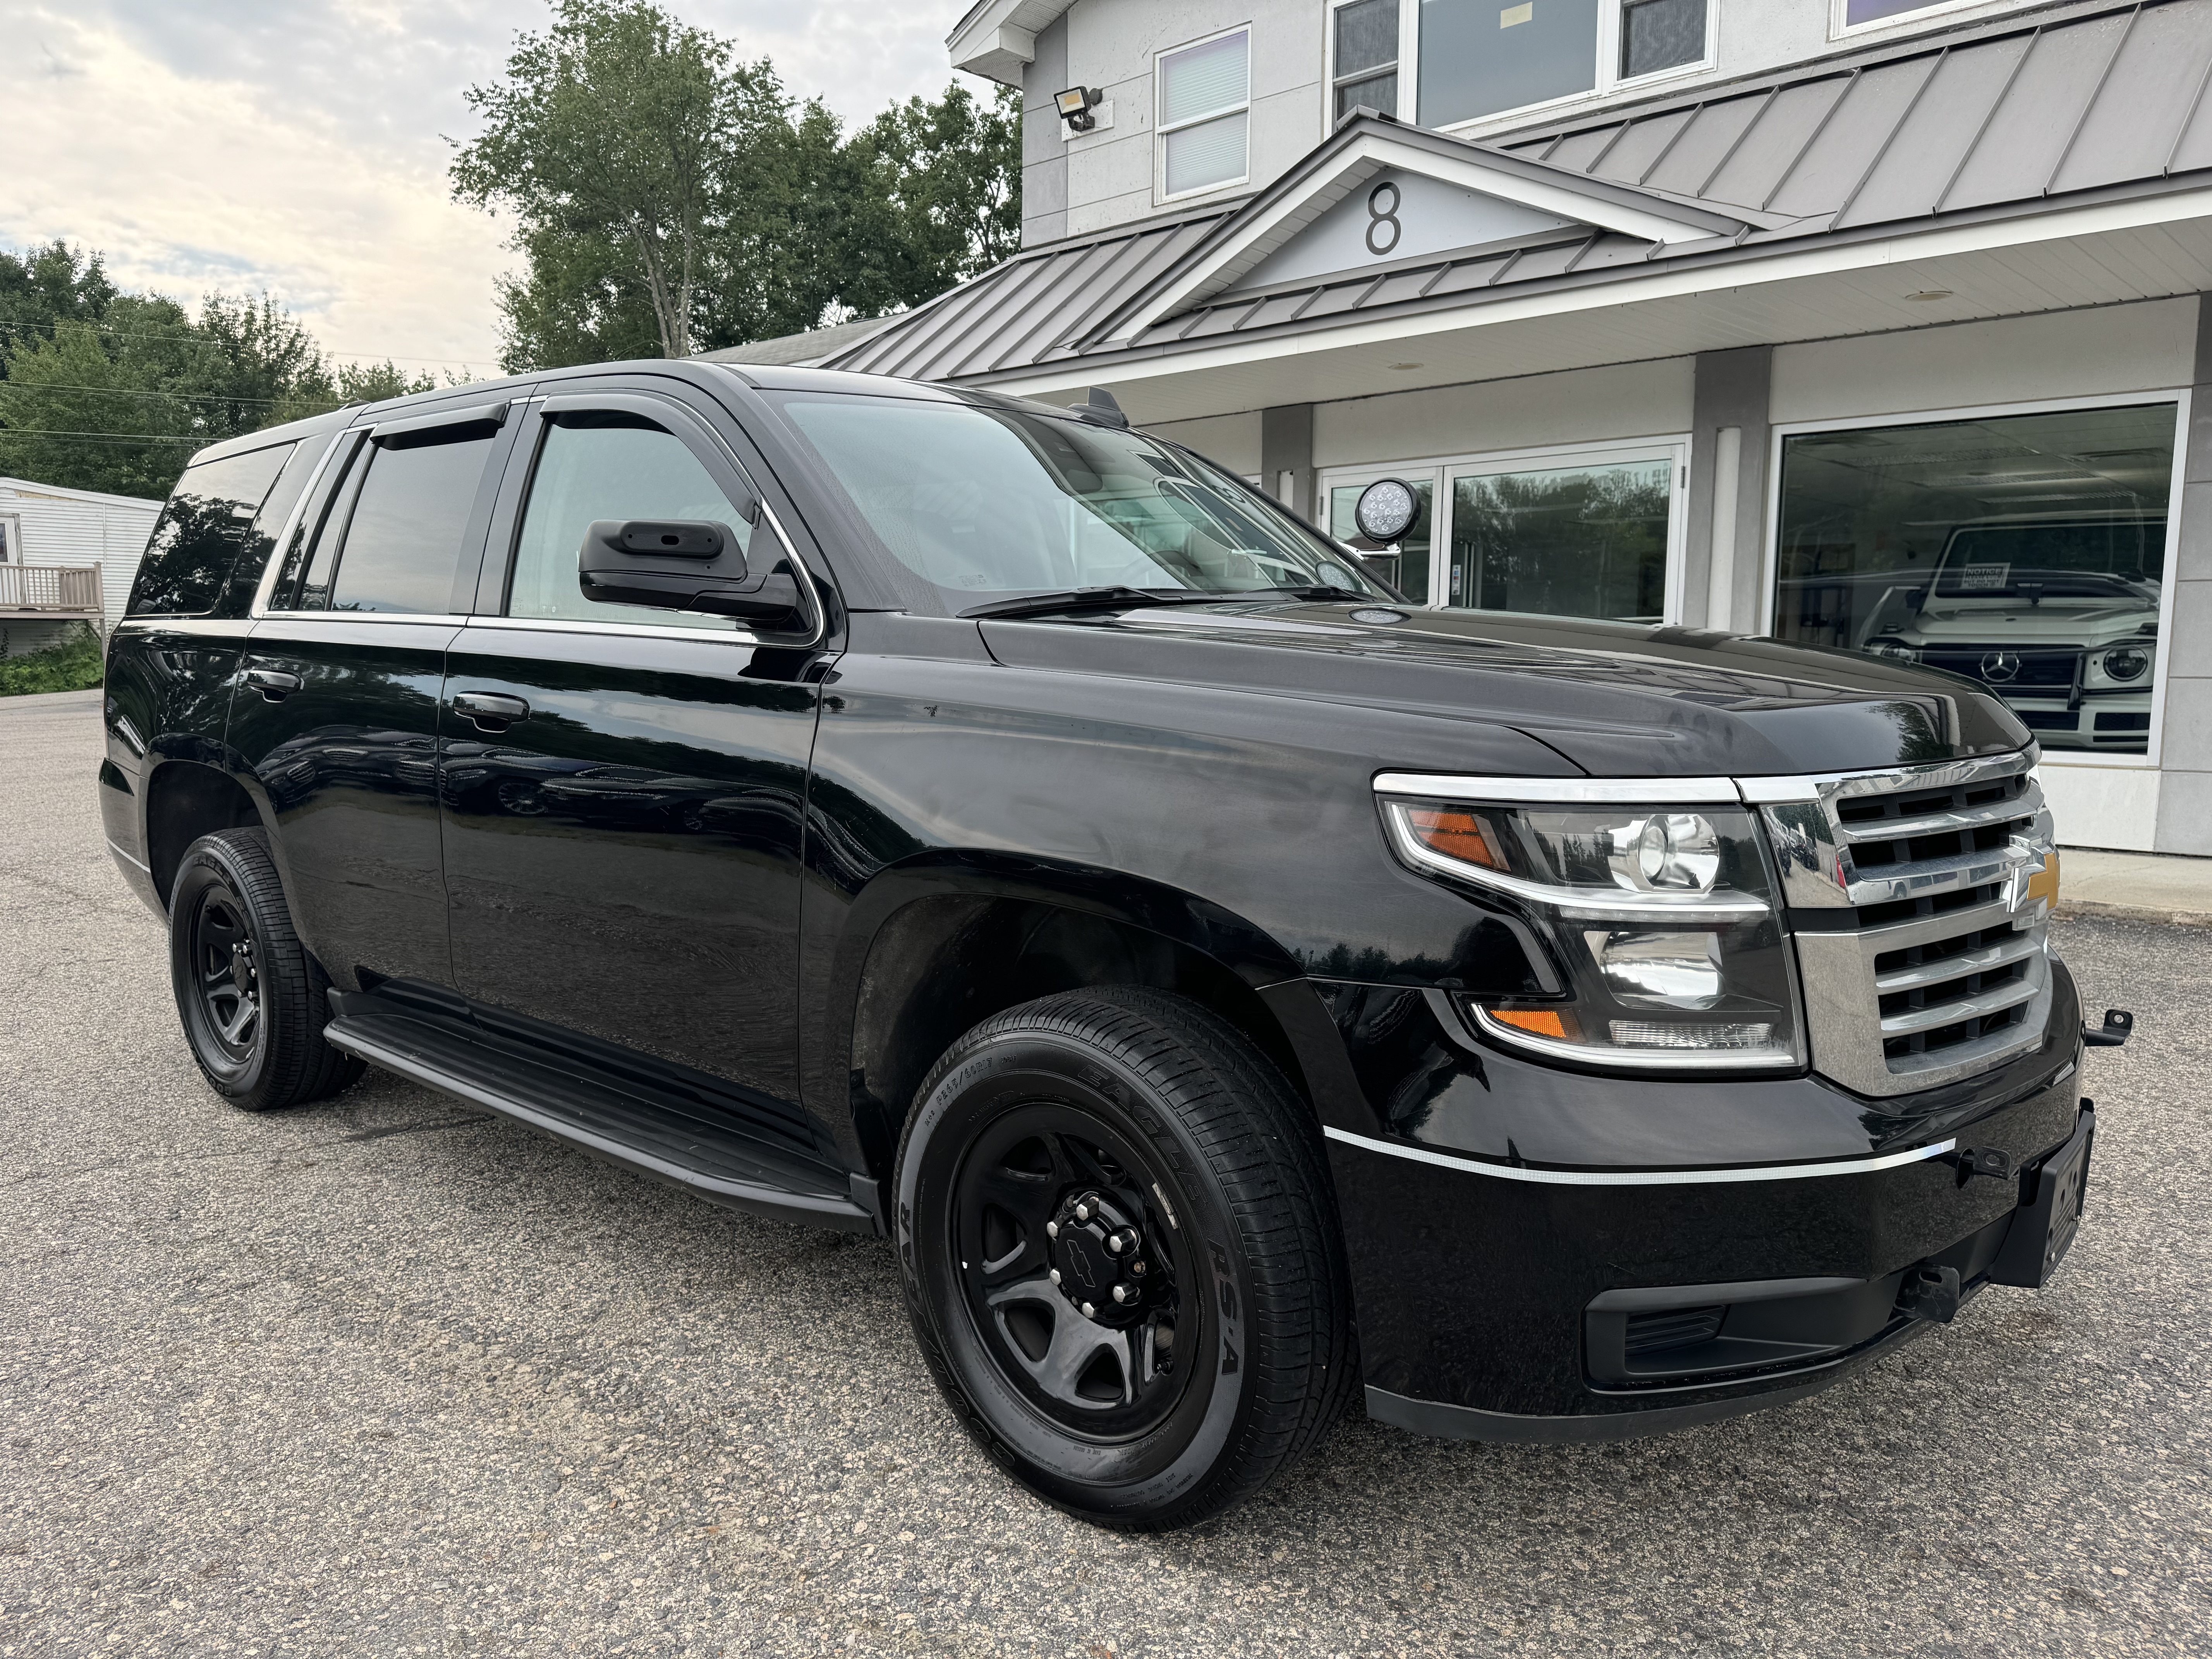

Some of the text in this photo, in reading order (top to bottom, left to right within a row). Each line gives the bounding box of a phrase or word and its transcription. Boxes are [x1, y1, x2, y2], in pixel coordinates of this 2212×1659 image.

[1366, 182, 1401, 256] 8
[193, 855, 232, 885] EAGLE
[936, 1057, 992, 1106] P265/60R17
[1078, 1065, 1207, 1202] EAGLE
[900, 1202, 1016, 1467] GOODYEAR
